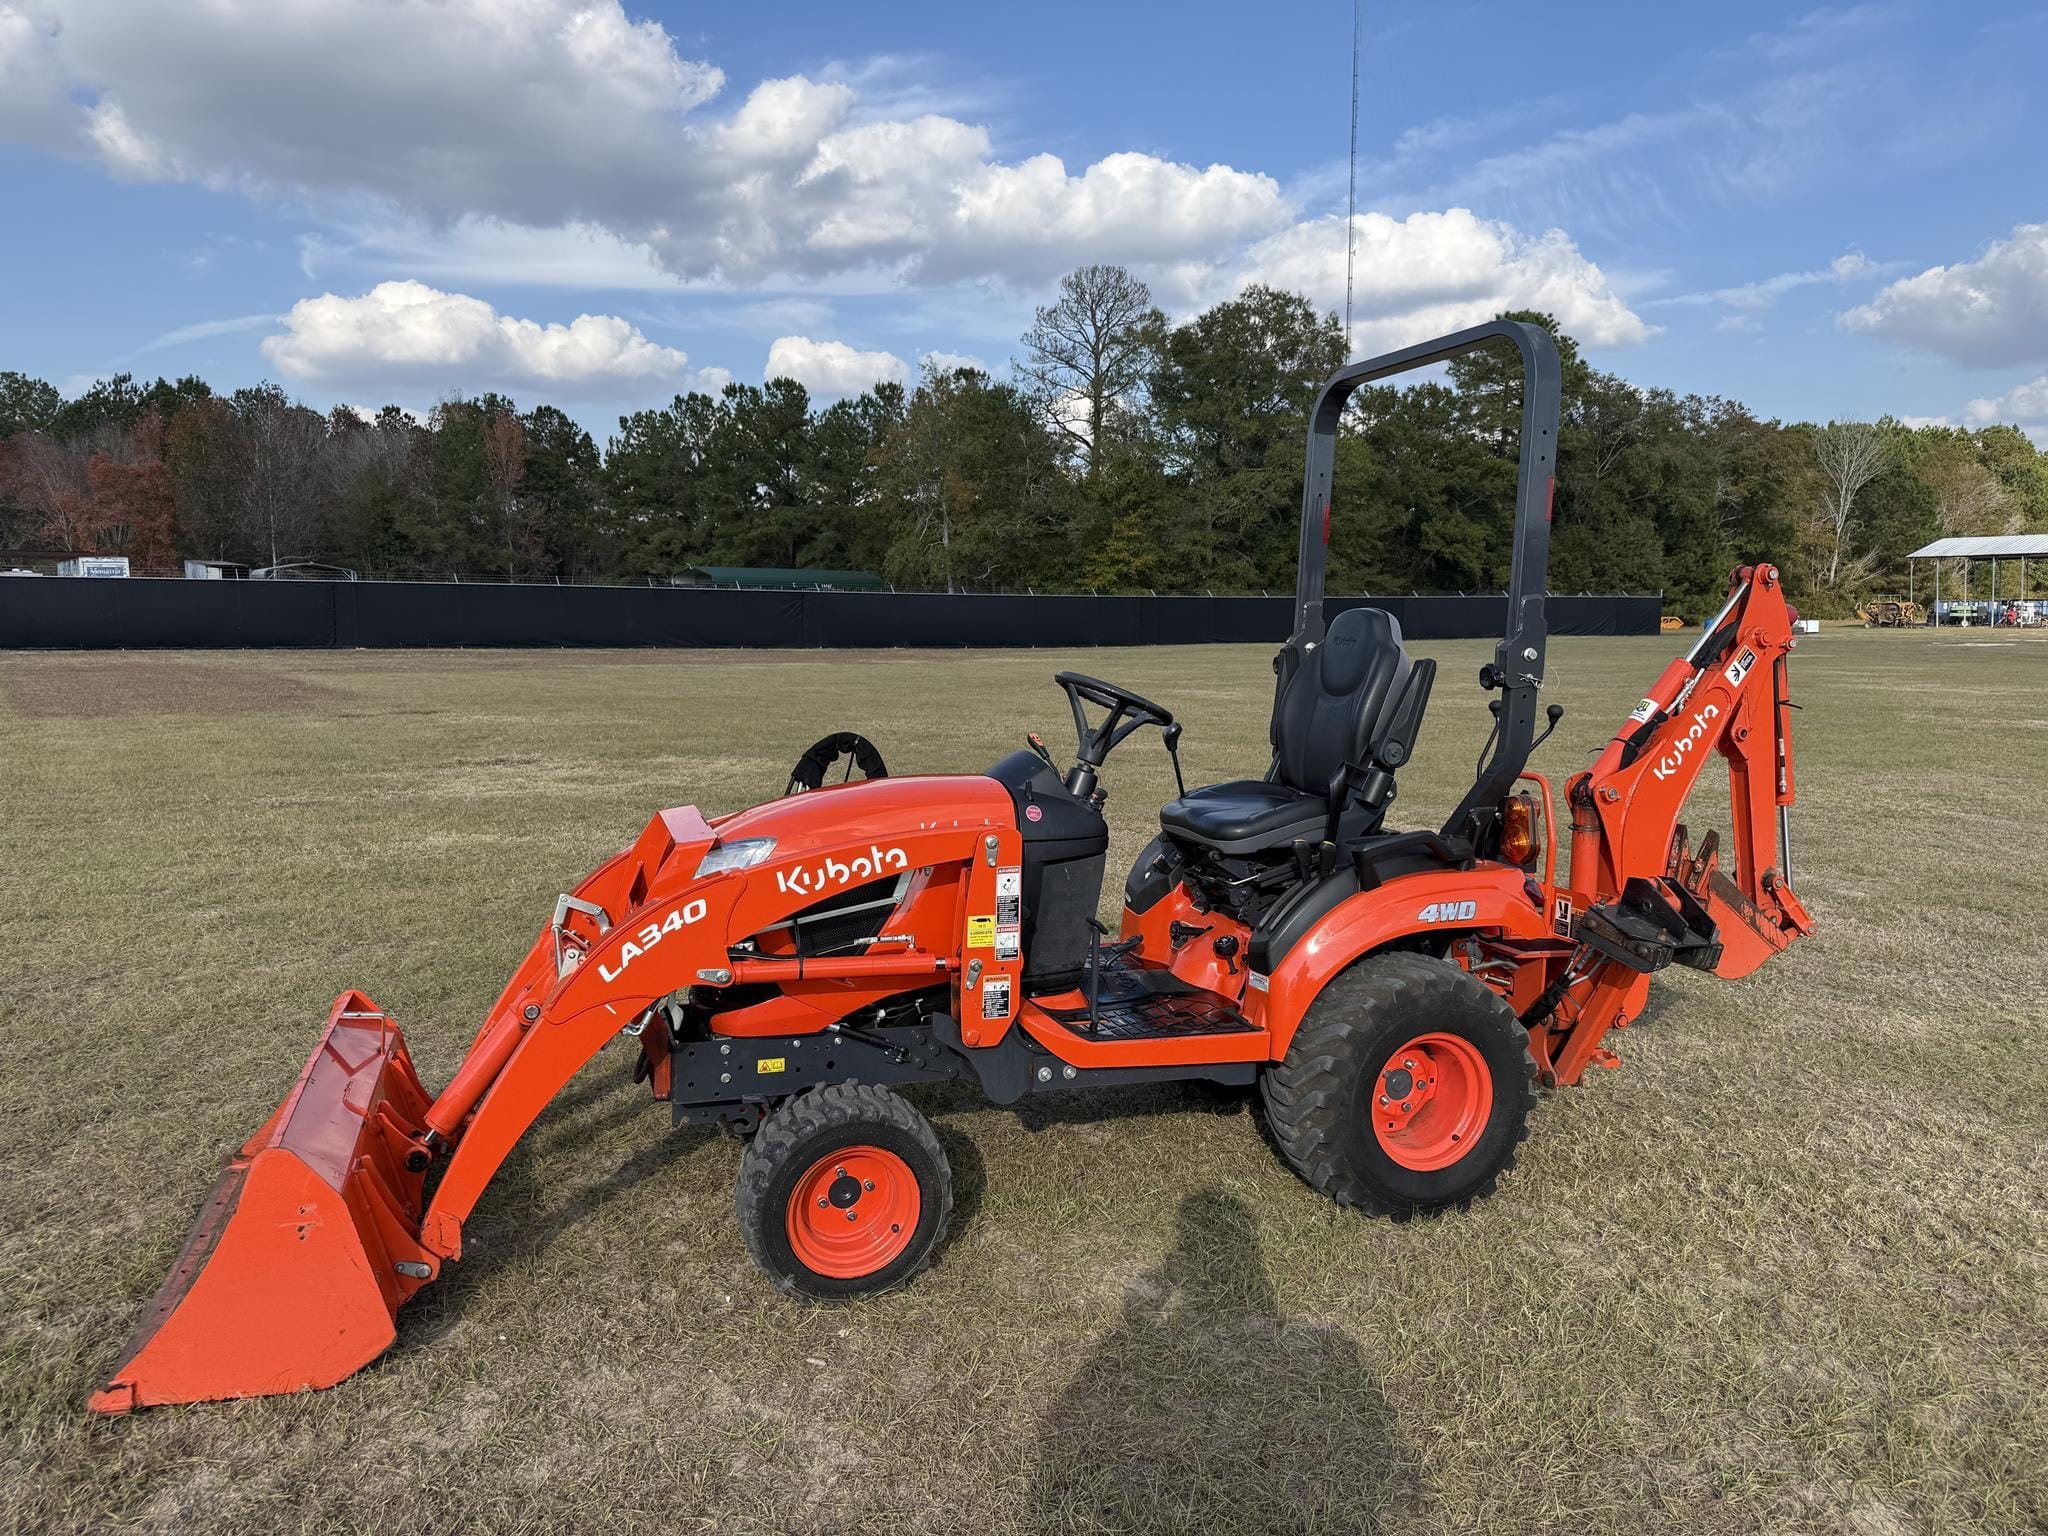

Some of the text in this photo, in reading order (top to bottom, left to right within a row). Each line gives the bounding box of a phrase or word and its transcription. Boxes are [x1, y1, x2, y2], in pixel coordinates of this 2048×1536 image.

[1653, 704, 1719, 781] Kubota
[776, 845, 909, 895] Kubota
[597, 898, 707, 983] LA340
[1417, 901, 1476, 923] 4WD
